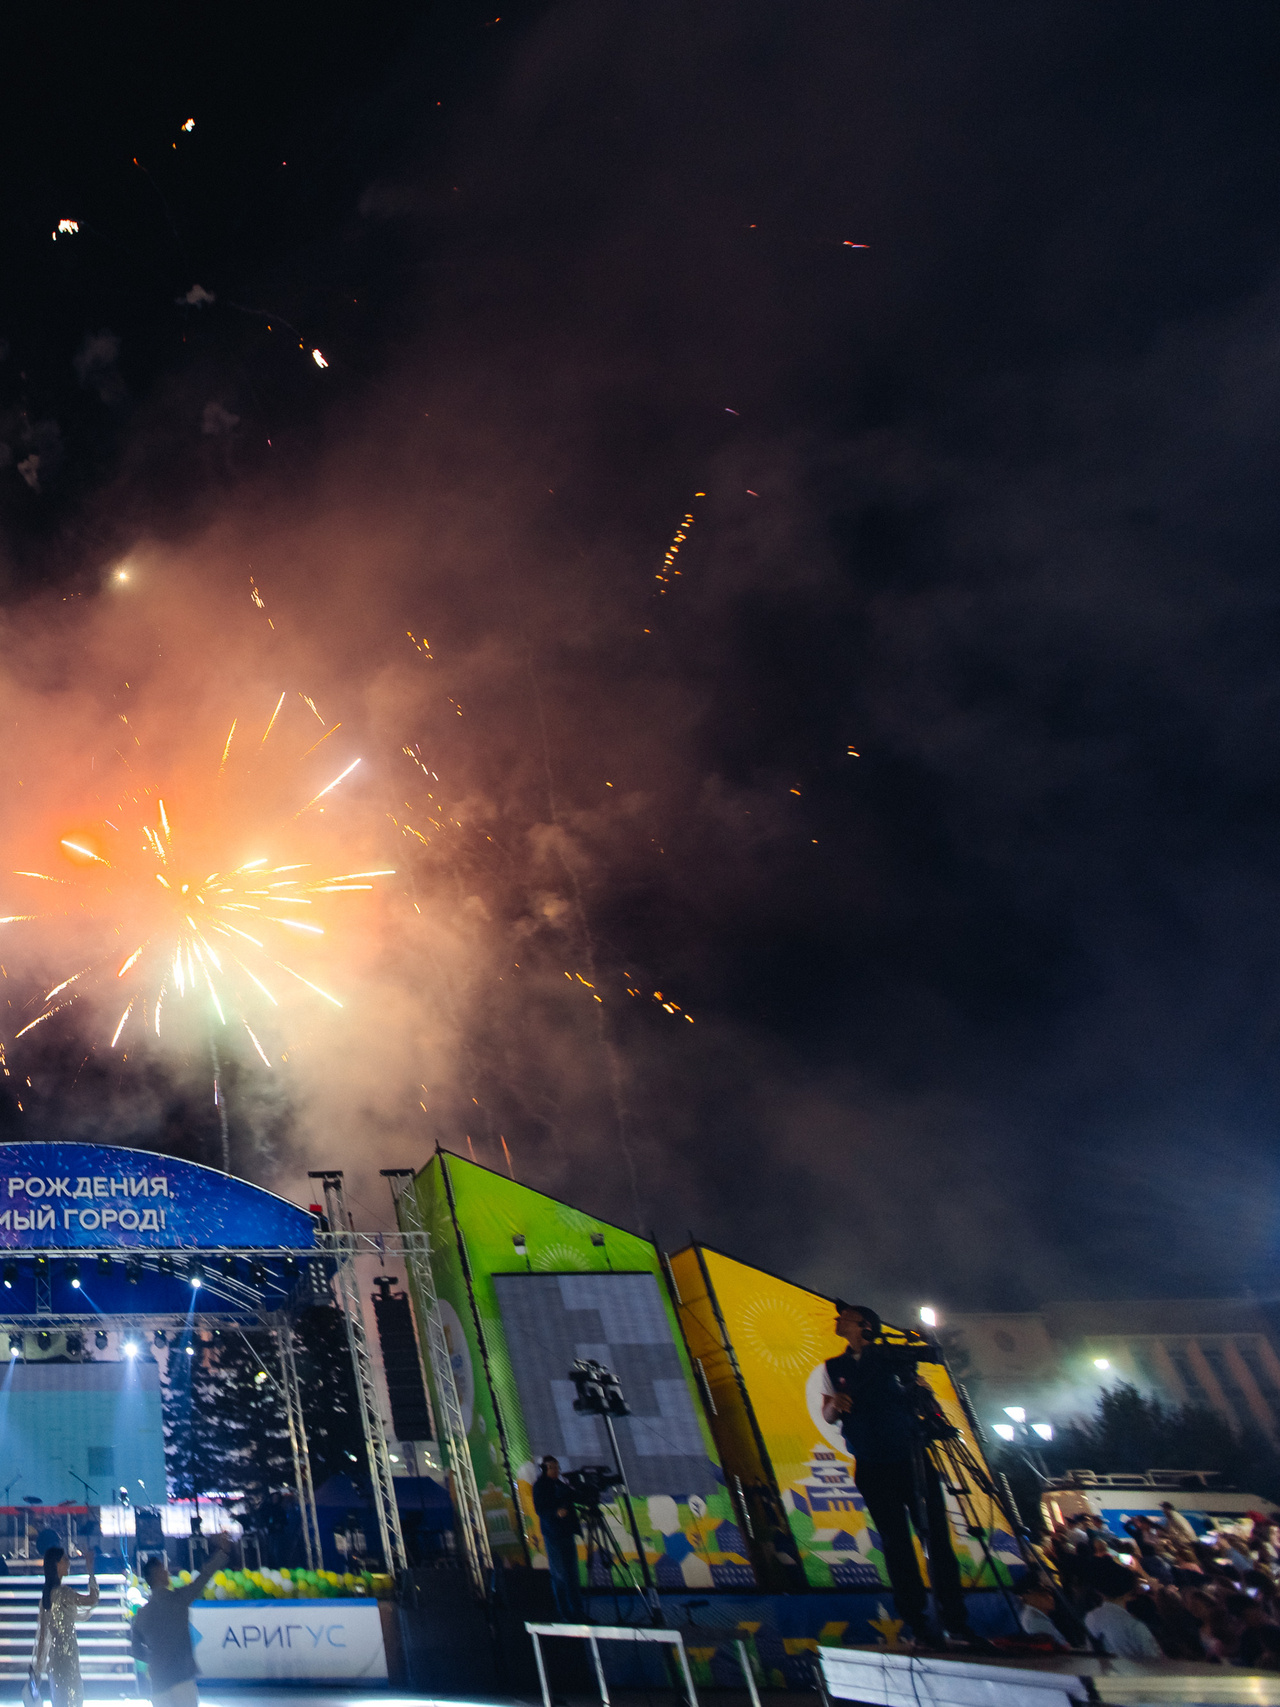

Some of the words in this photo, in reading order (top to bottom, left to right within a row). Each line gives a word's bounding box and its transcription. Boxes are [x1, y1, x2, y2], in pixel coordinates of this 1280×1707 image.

[7, 1176, 176, 1200] РОЖДЕНИЯ,
[63, 1208, 167, 1233] ГОРОД!
[221, 1624, 348, 1649] АРИГУС
